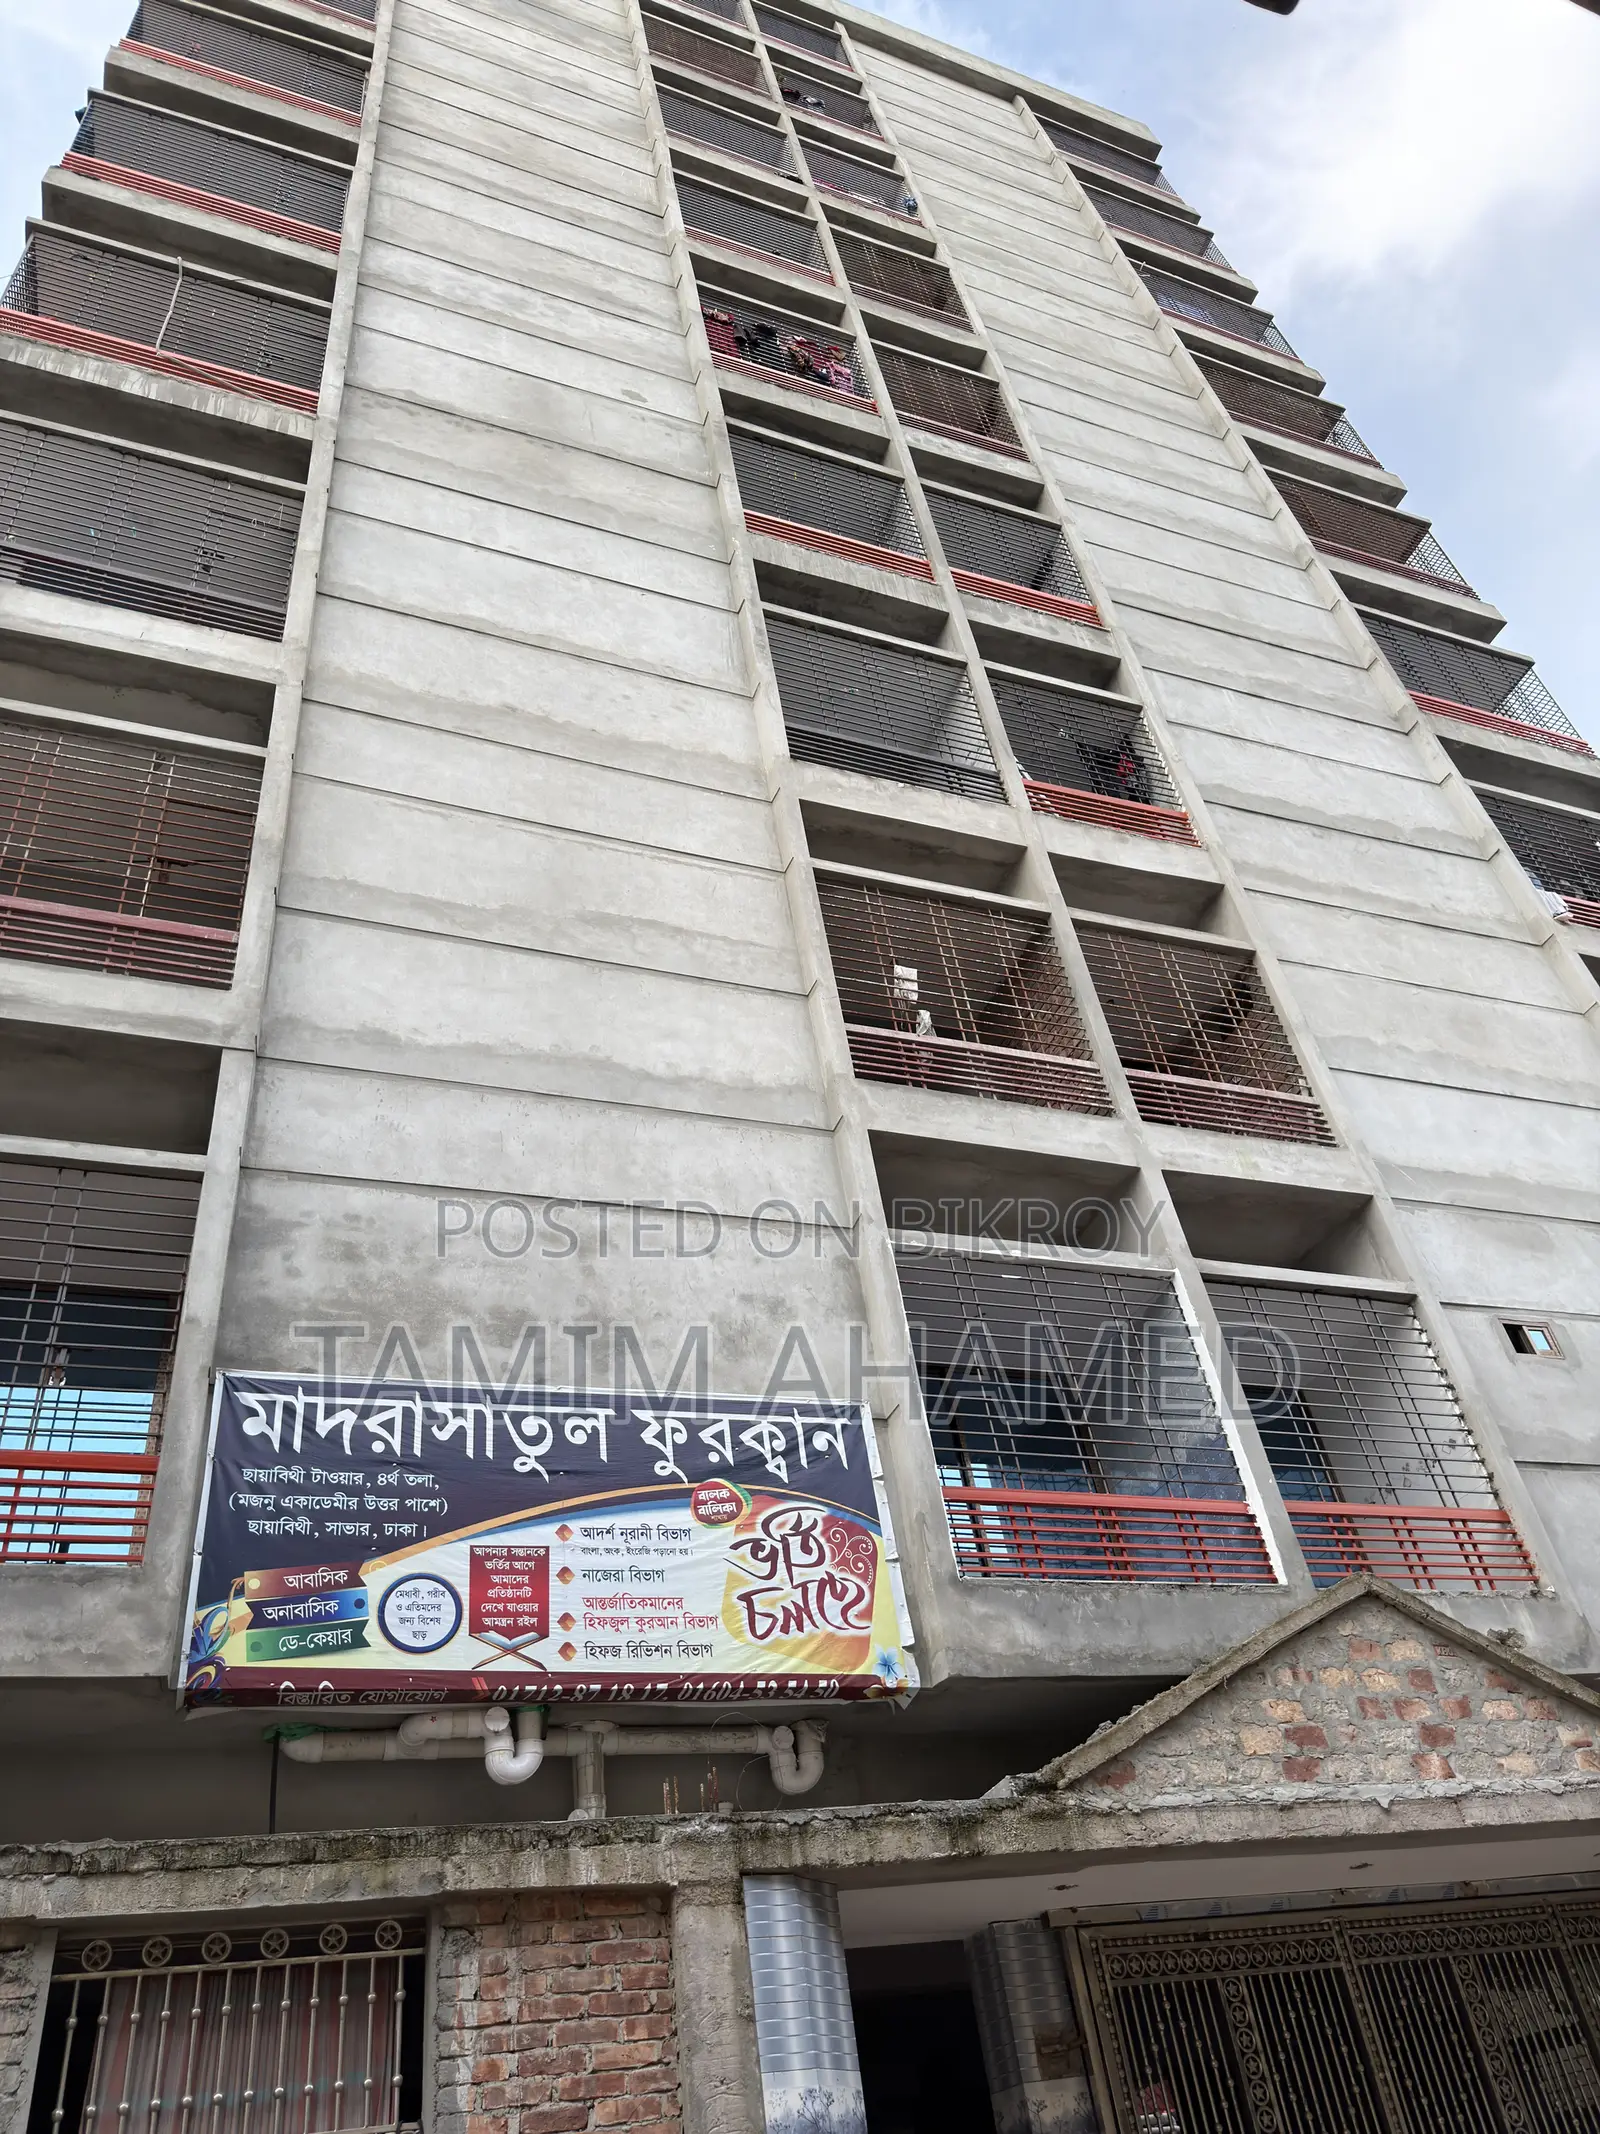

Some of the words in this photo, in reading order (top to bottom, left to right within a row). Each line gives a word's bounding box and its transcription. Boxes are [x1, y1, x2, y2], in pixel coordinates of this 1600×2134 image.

[234, 1385, 617, 1483] মাদরাসাতুল
[630, 1407, 852, 1485] ফুরক্বান
[242, 1465, 306, 1484] ছায়াবিথী
[377, 1468, 398, 1487] ৪র্থ
[404, 1472, 439, 1490] তলা,
[228, 1491, 275, 1512] (মজনু
[281, 1492, 358, 1511] একাডেমীর
[363, 1493, 400, 1512] উত্তর
[405, 1496, 449, 1516] পাশে)
[697, 1488, 731, 1501] বালক
[697, 1500, 737, 1516] বালিকা
[325, 1520, 377, 1540] সাভার,
[580, 1523, 616, 1541] আদর্শ
[619, 1522, 653, 1545] নূরানী
[656, 1523, 691, 1541] বিভাগ
[472, 1547, 508, 1557] আপনার
[510, 1547, 547, 1557] সন্তানকে
[722, 1506, 827, 1588] ভর্তি
[484, 1559, 510, 1570] ভর্তির
[512, 1560, 535, 1571] আগে
[581, 1568, 625, 1583] নাজেরা
[628, 1565, 665, 1583] বিভাগ
[283, 1566, 350, 1589] আবাসিক
[490, 1575, 530, 1585] আমাদের
[487, 1586, 532, 1599] প্রতিষ্ঠানটি
[582, 1592, 684, 1611] আন্তর্জাতিকমানের
[262, 1597, 340, 1621] অনাবাসিক
[405, 1602, 442, 1612] এতিমদের
[480, 1602, 504, 1613] দেখে
[506, 1602, 540, 1613] যাওয়ার
[736, 1570, 871, 1641] চলছে
[398, 1616, 415, 1626] জন্য
[417, 1614, 441, 1626] বিশেষ
[517, 1615, 538, 1628] রইল
[583, 1612, 630, 1632] হিফজুল
[633, 1616, 679, 1633] কুরআন
[683, 1612, 719, 1631] বিভাগ
[279, 1628, 353, 1652] ডে-কেয়ার
[412, 1631, 428, 1641] ছাড়
[583, 1640, 623, 1659] হিফজ
[625, 1640, 674, 1659] রিভিশন
[676, 1640, 714, 1658] বিভাগ
[276, 1680, 355, 1705] বিস্তারিত
[358, 1687, 449, 1704] যোগাযোগ
